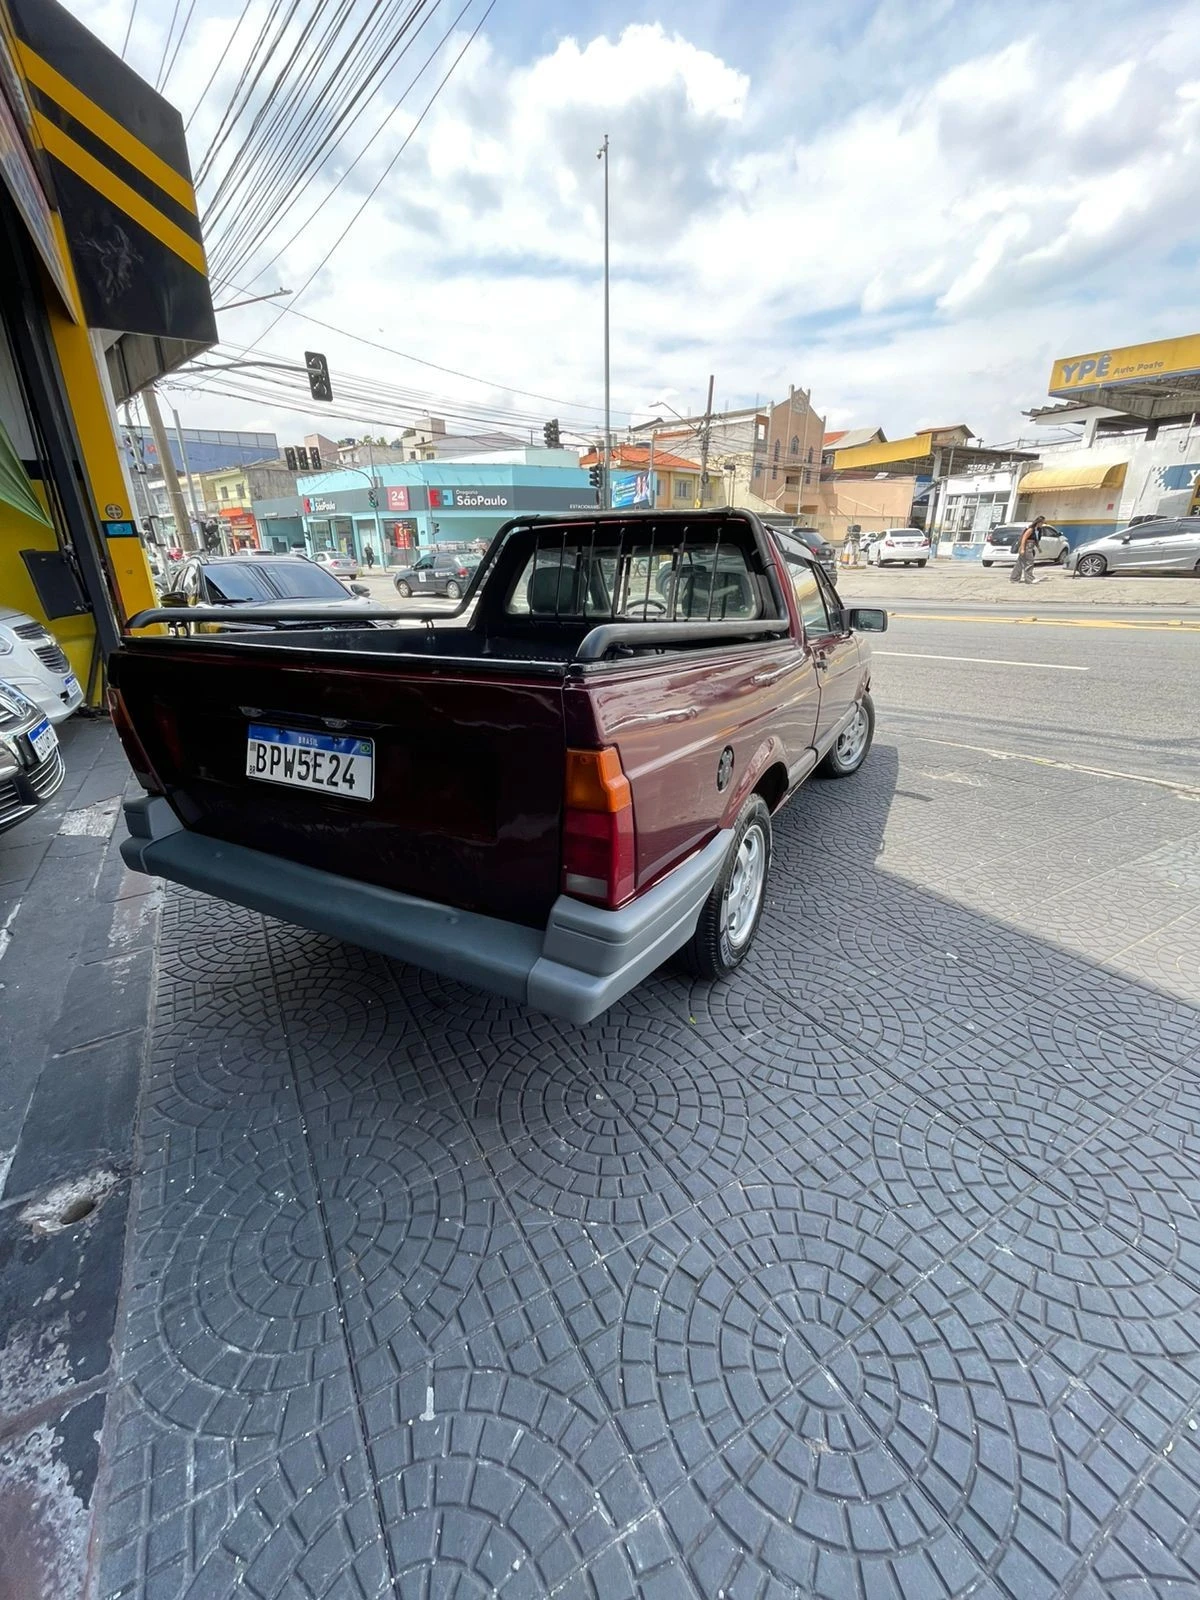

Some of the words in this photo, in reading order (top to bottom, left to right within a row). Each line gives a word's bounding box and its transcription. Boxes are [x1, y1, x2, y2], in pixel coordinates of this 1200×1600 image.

[1062, 353, 1112, 383] YPÊ
[1113, 367, 1135, 375] Auto
[1137, 361, 1164, 371] Posto
[391, 491, 405, 501] 24
[298, 736, 318, 747] BRASIL
[256, 743, 356, 790] BPW5E24
